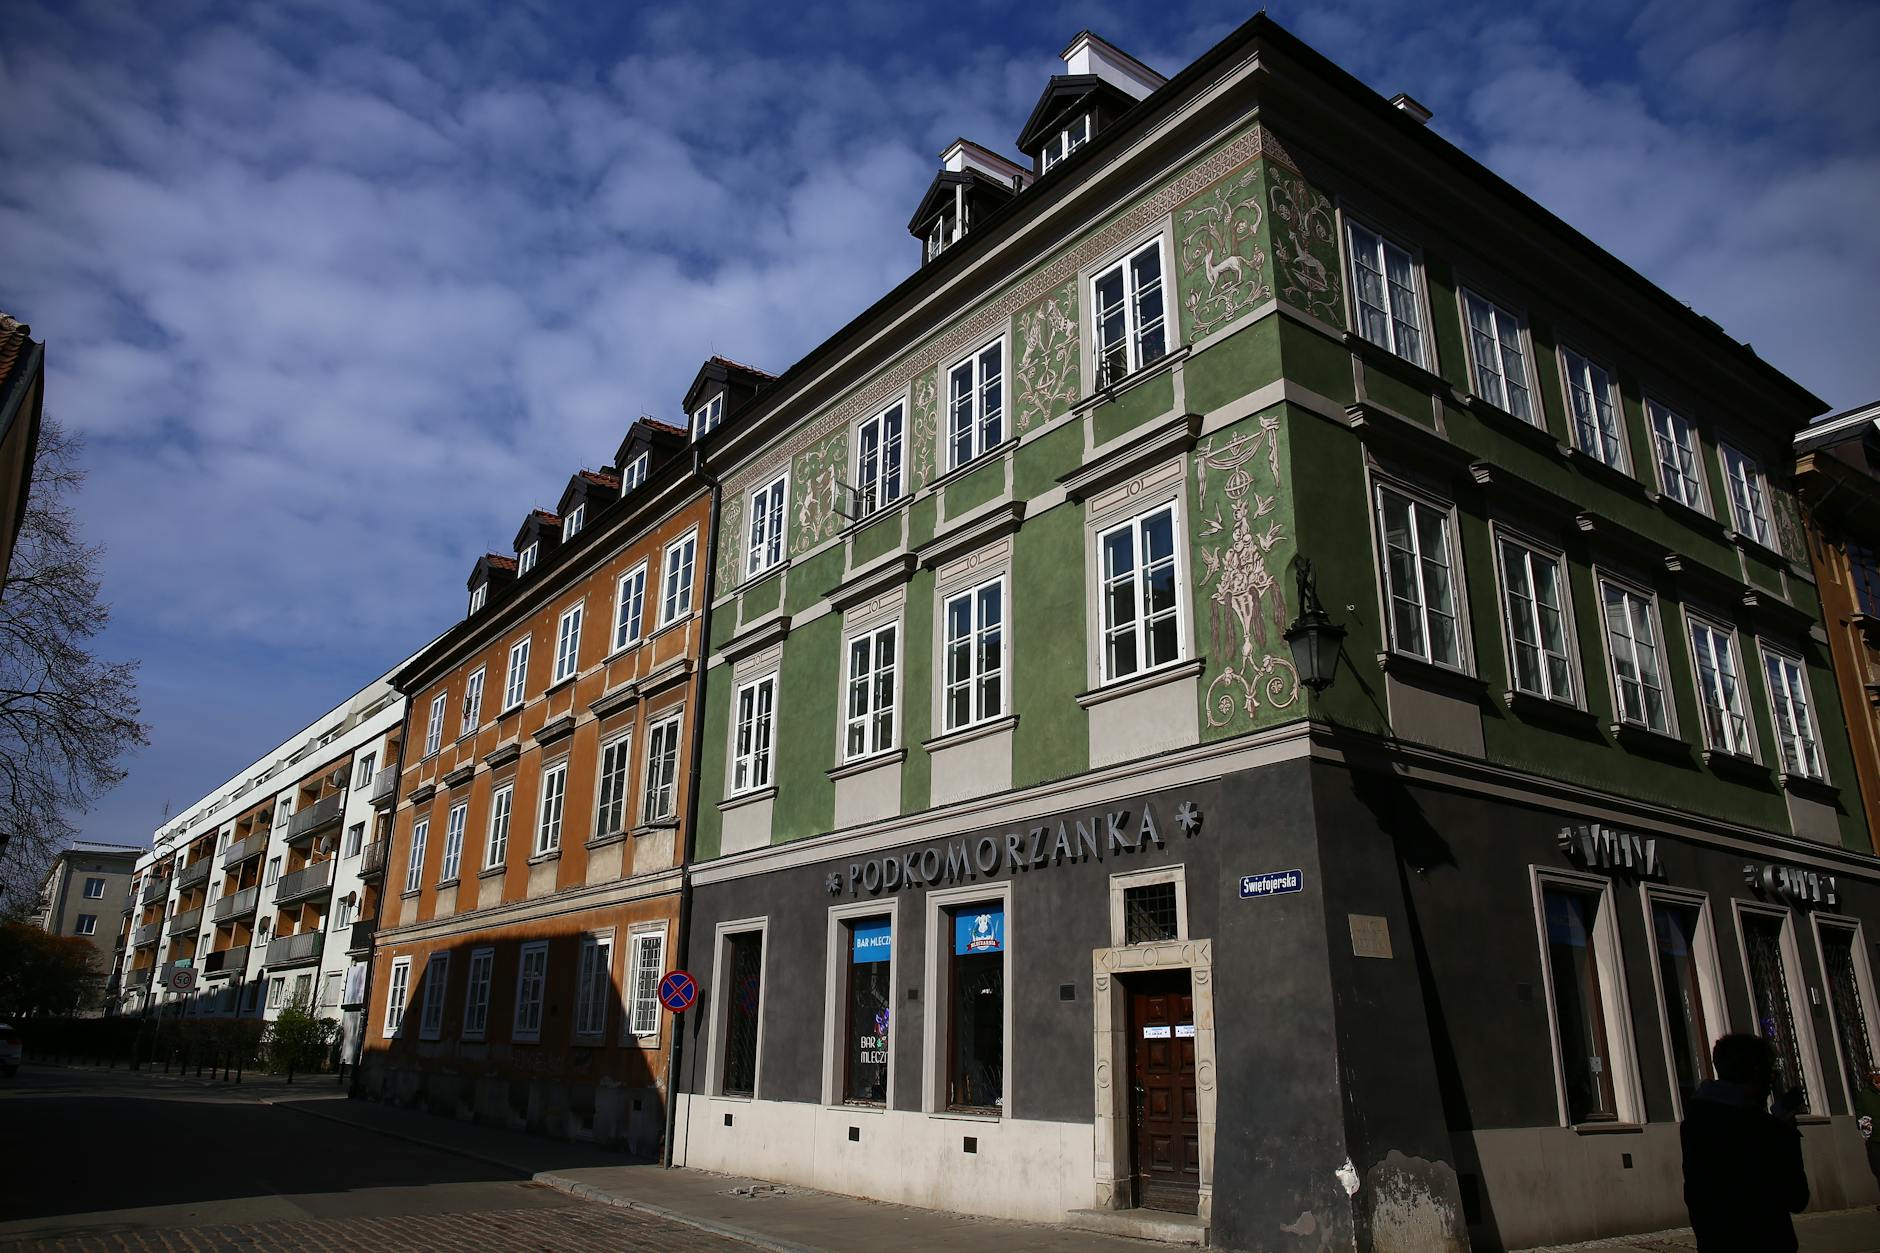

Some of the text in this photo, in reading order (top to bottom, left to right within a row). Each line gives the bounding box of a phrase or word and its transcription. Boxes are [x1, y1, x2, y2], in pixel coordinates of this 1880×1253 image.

[849, 802, 1161, 894] PODKOMORZANKA
[1243, 873, 1297, 894] Świętojerska
[856, 937, 870, 948] BAR
[176, 975, 190, 985] 50
[860, 1036, 876, 1049] BAR
